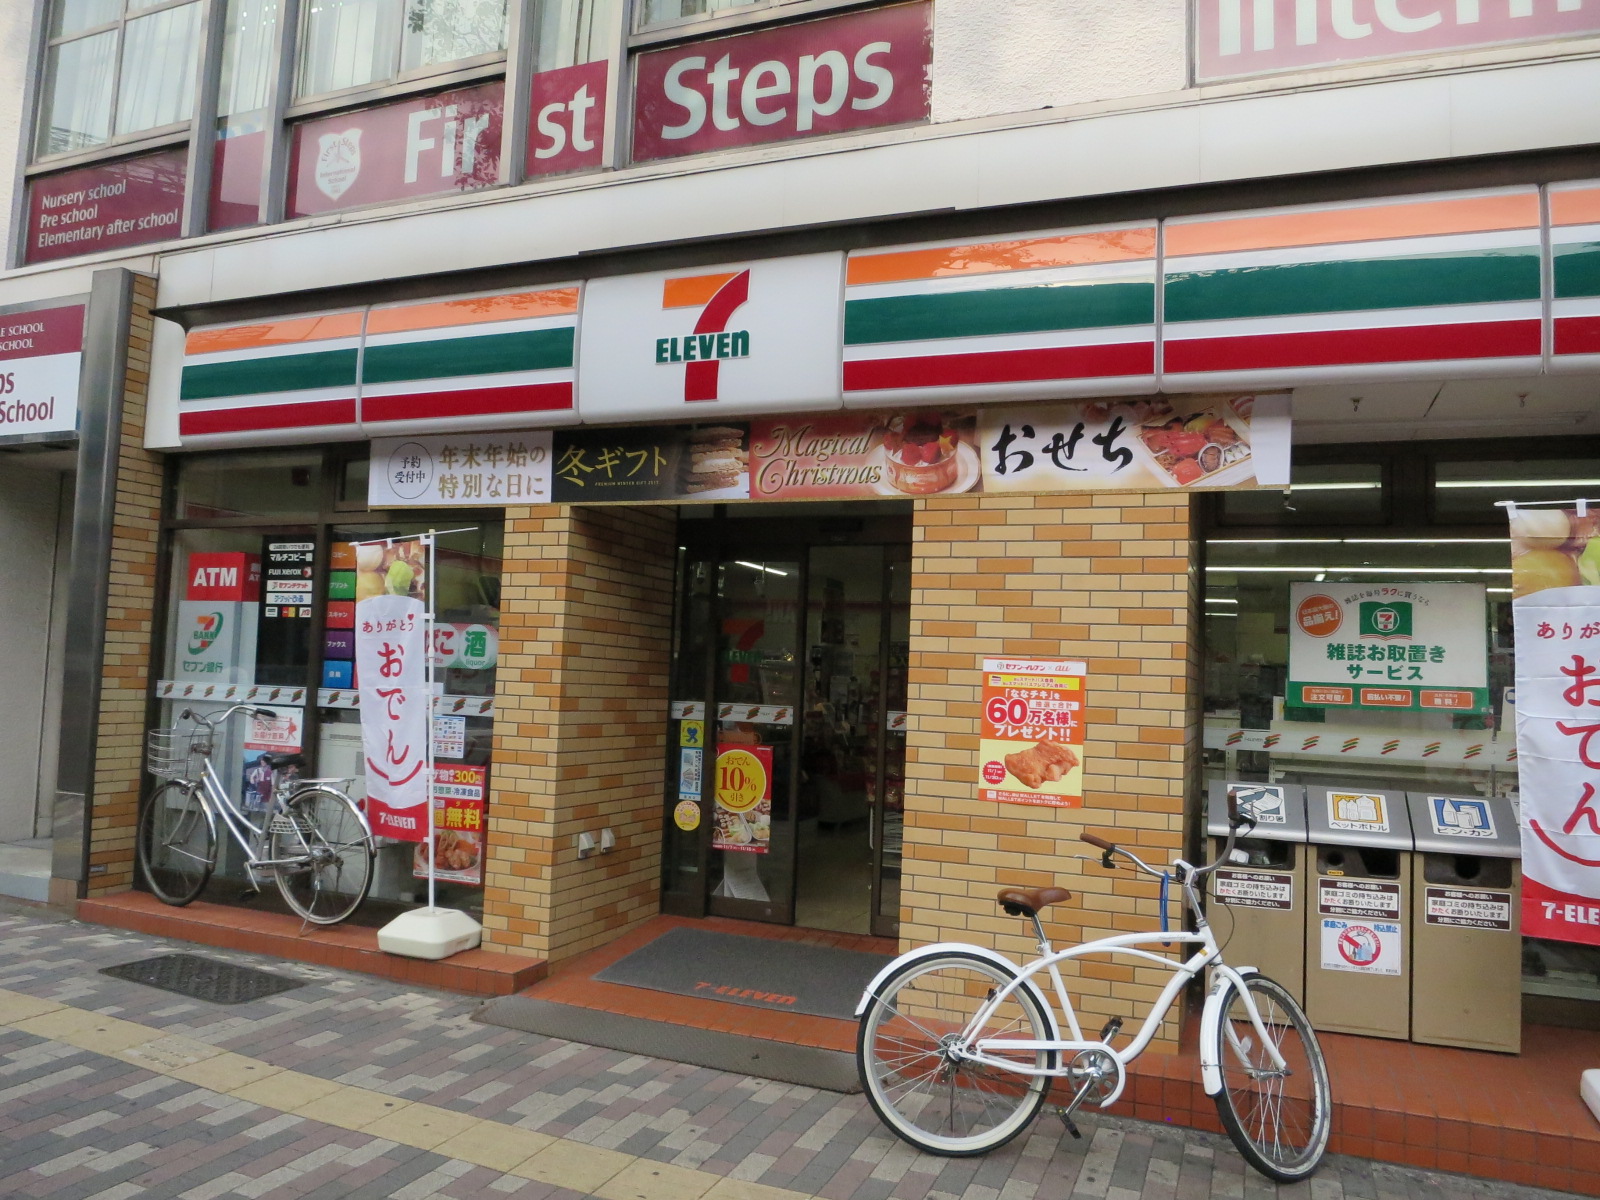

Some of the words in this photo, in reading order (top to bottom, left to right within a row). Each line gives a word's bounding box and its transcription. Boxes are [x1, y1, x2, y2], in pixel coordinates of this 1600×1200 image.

[661, 41, 894, 140] Steps
[41, 190, 86, 210] Nursery
[87, 179, 127, 200] school
[38, 224, 105, 248] Elementary
[106, 219, 135, 236] after
[137, 208, 179, 230] school
[40, 214, 59, 229] Pre
[60, 204, 98, 225] school
[8, 322, 45, 337] SCHOOL
[753, 424, 874, 461] Magical
[992, 416, 1134, 475] おせち
[400, 456, 421, 469] 予約
[438, 442, 546, 471] 年末年始の
[555, 444, 667, 487] 冬ギフト
[394, 471, 426, 484] 受付中
[438, 473, 545, 499] 特別な日に
[758, 458, 882, 495] Christmas
[193, 567, 238, 586] ATM
[362, 619, 414, 633] ありがとう
[464, 631, 487, 657] 酒
[1327, 643, 1446, 663] 雑誌お取置き
[183, 661, 223, 673] セブン銀行
[1347, 664, 1424, 681] サービス
[376, 642, 409, 766] おでん
[726, 756, 750, 765] おでん
[719, 767, 757, 792] 10%
[1331, 821, 1388, 832] ペットボトル
[1437, 827, 1494, 836] ビン・カン
[1541, 901, 1600, 926] 7-ELE
